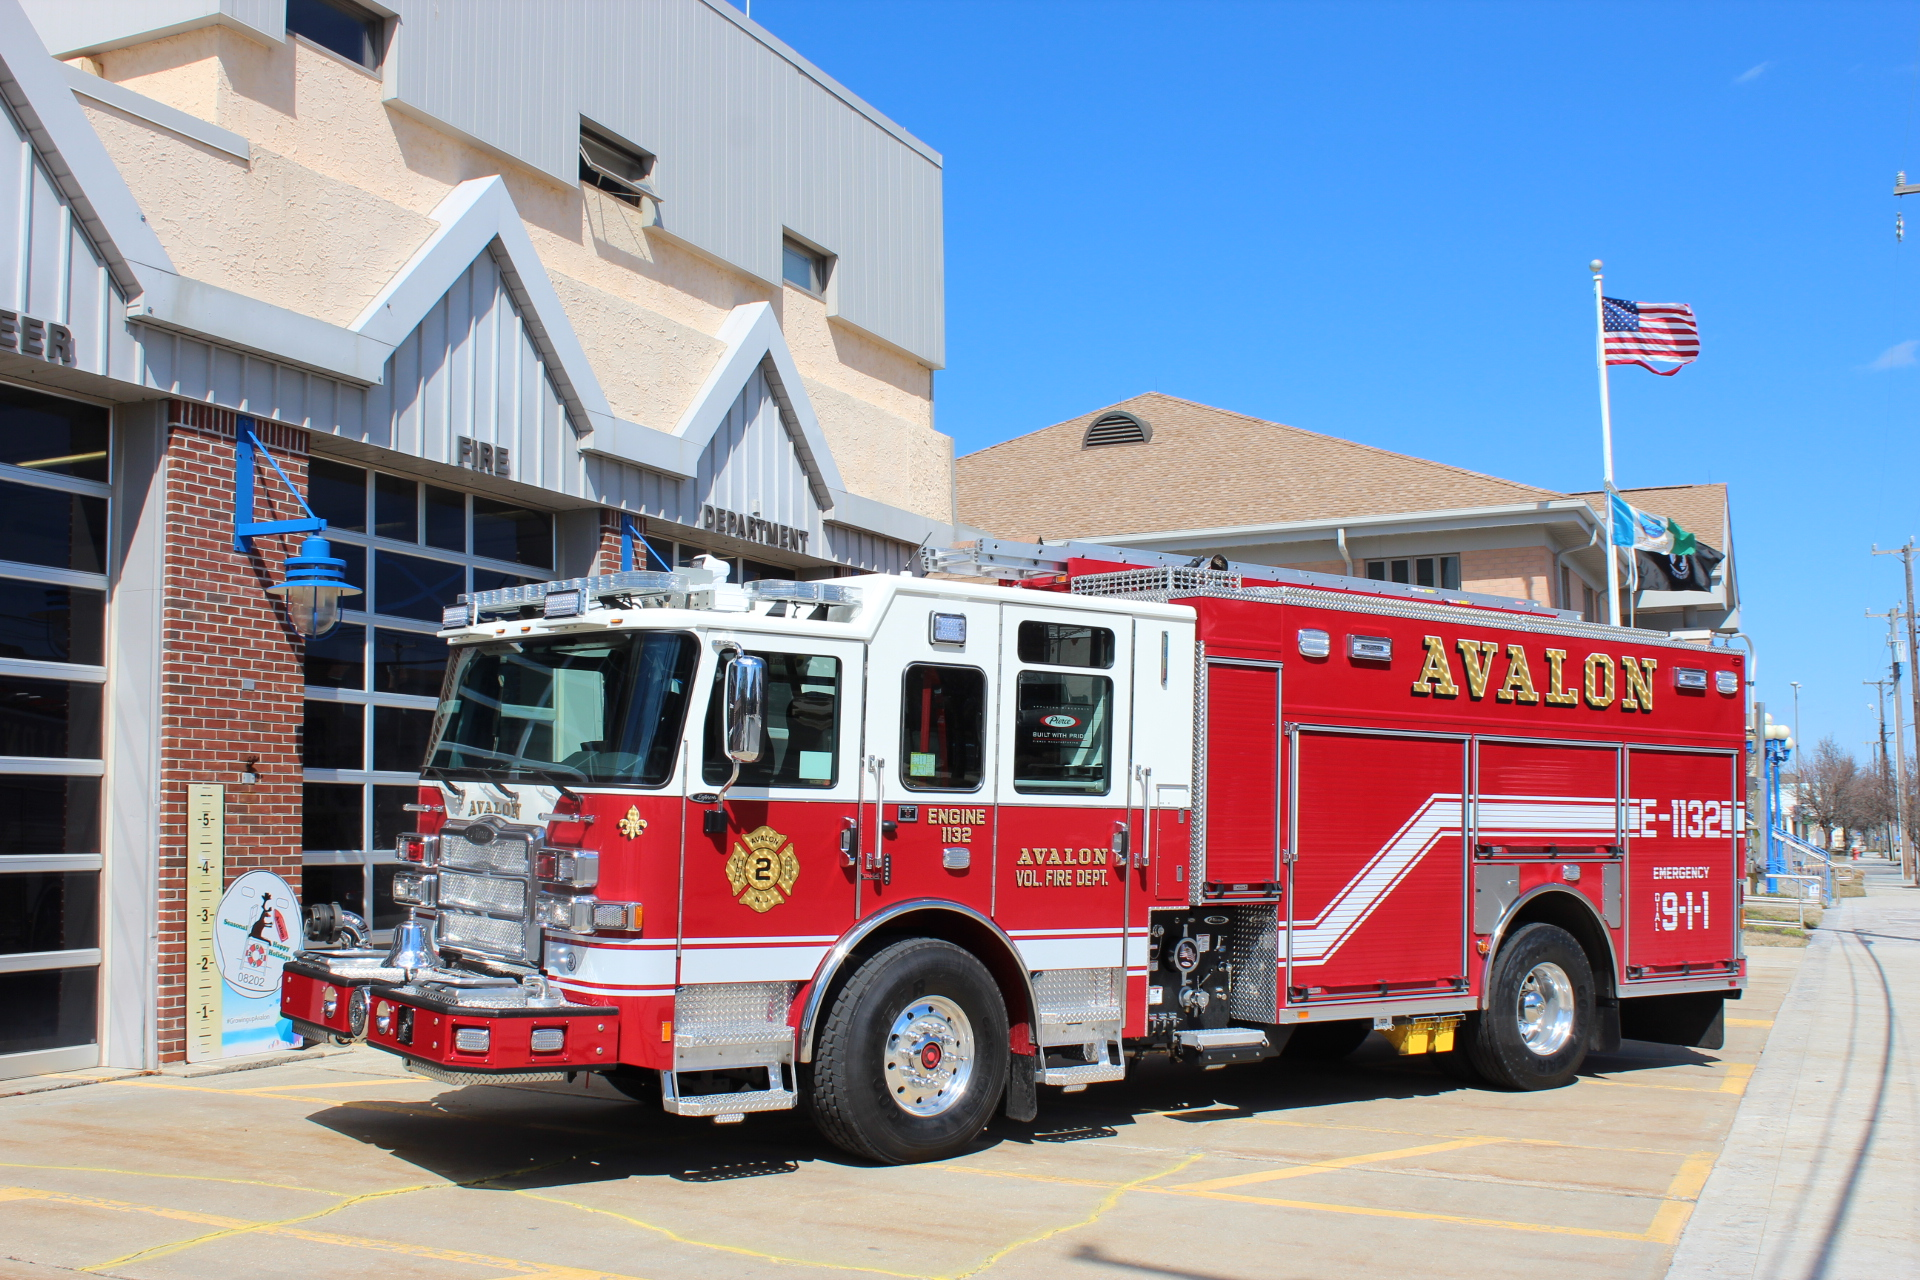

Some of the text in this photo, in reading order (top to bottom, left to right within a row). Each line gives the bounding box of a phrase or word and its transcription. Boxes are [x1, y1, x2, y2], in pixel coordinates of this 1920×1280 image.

[457, 435, 509, 475] FIRE
[703, 504, 809, 553] DEPARTMENT
[1413, 635, 1657, 710] AVALON
[1049, 716, 1071, 725] Pierce
[468, 800, 522, 820] AVALON
[928, 808, 986, 825] ENGINE
[203, 813, 210, 826] 5
[1641, 799, 1721, 838] E-1132
[751, 834, 779, 846] AVALON
[942, 827, 972, 843] 1132
[1017, 848, 1109, 865] AVALON
[202, 861, 210, 874] 4
[755, 858, 771, 880] 2
[1653, 866, 1710, 880] EMERGENCY
[1016, 870, 1109, 887] VOL. FIRE DEPT.
[202, 909, 209, 922] 3
[1662, 891, 1709, 931] 9-1-1
[272, 941, 291, 953] Happy
[268, 949, 292, 962] Holidays
[202, 957, 209, 970] 2
[237, 972, 265, 987] 08202
[202, 1005, 209, 1018] 1
